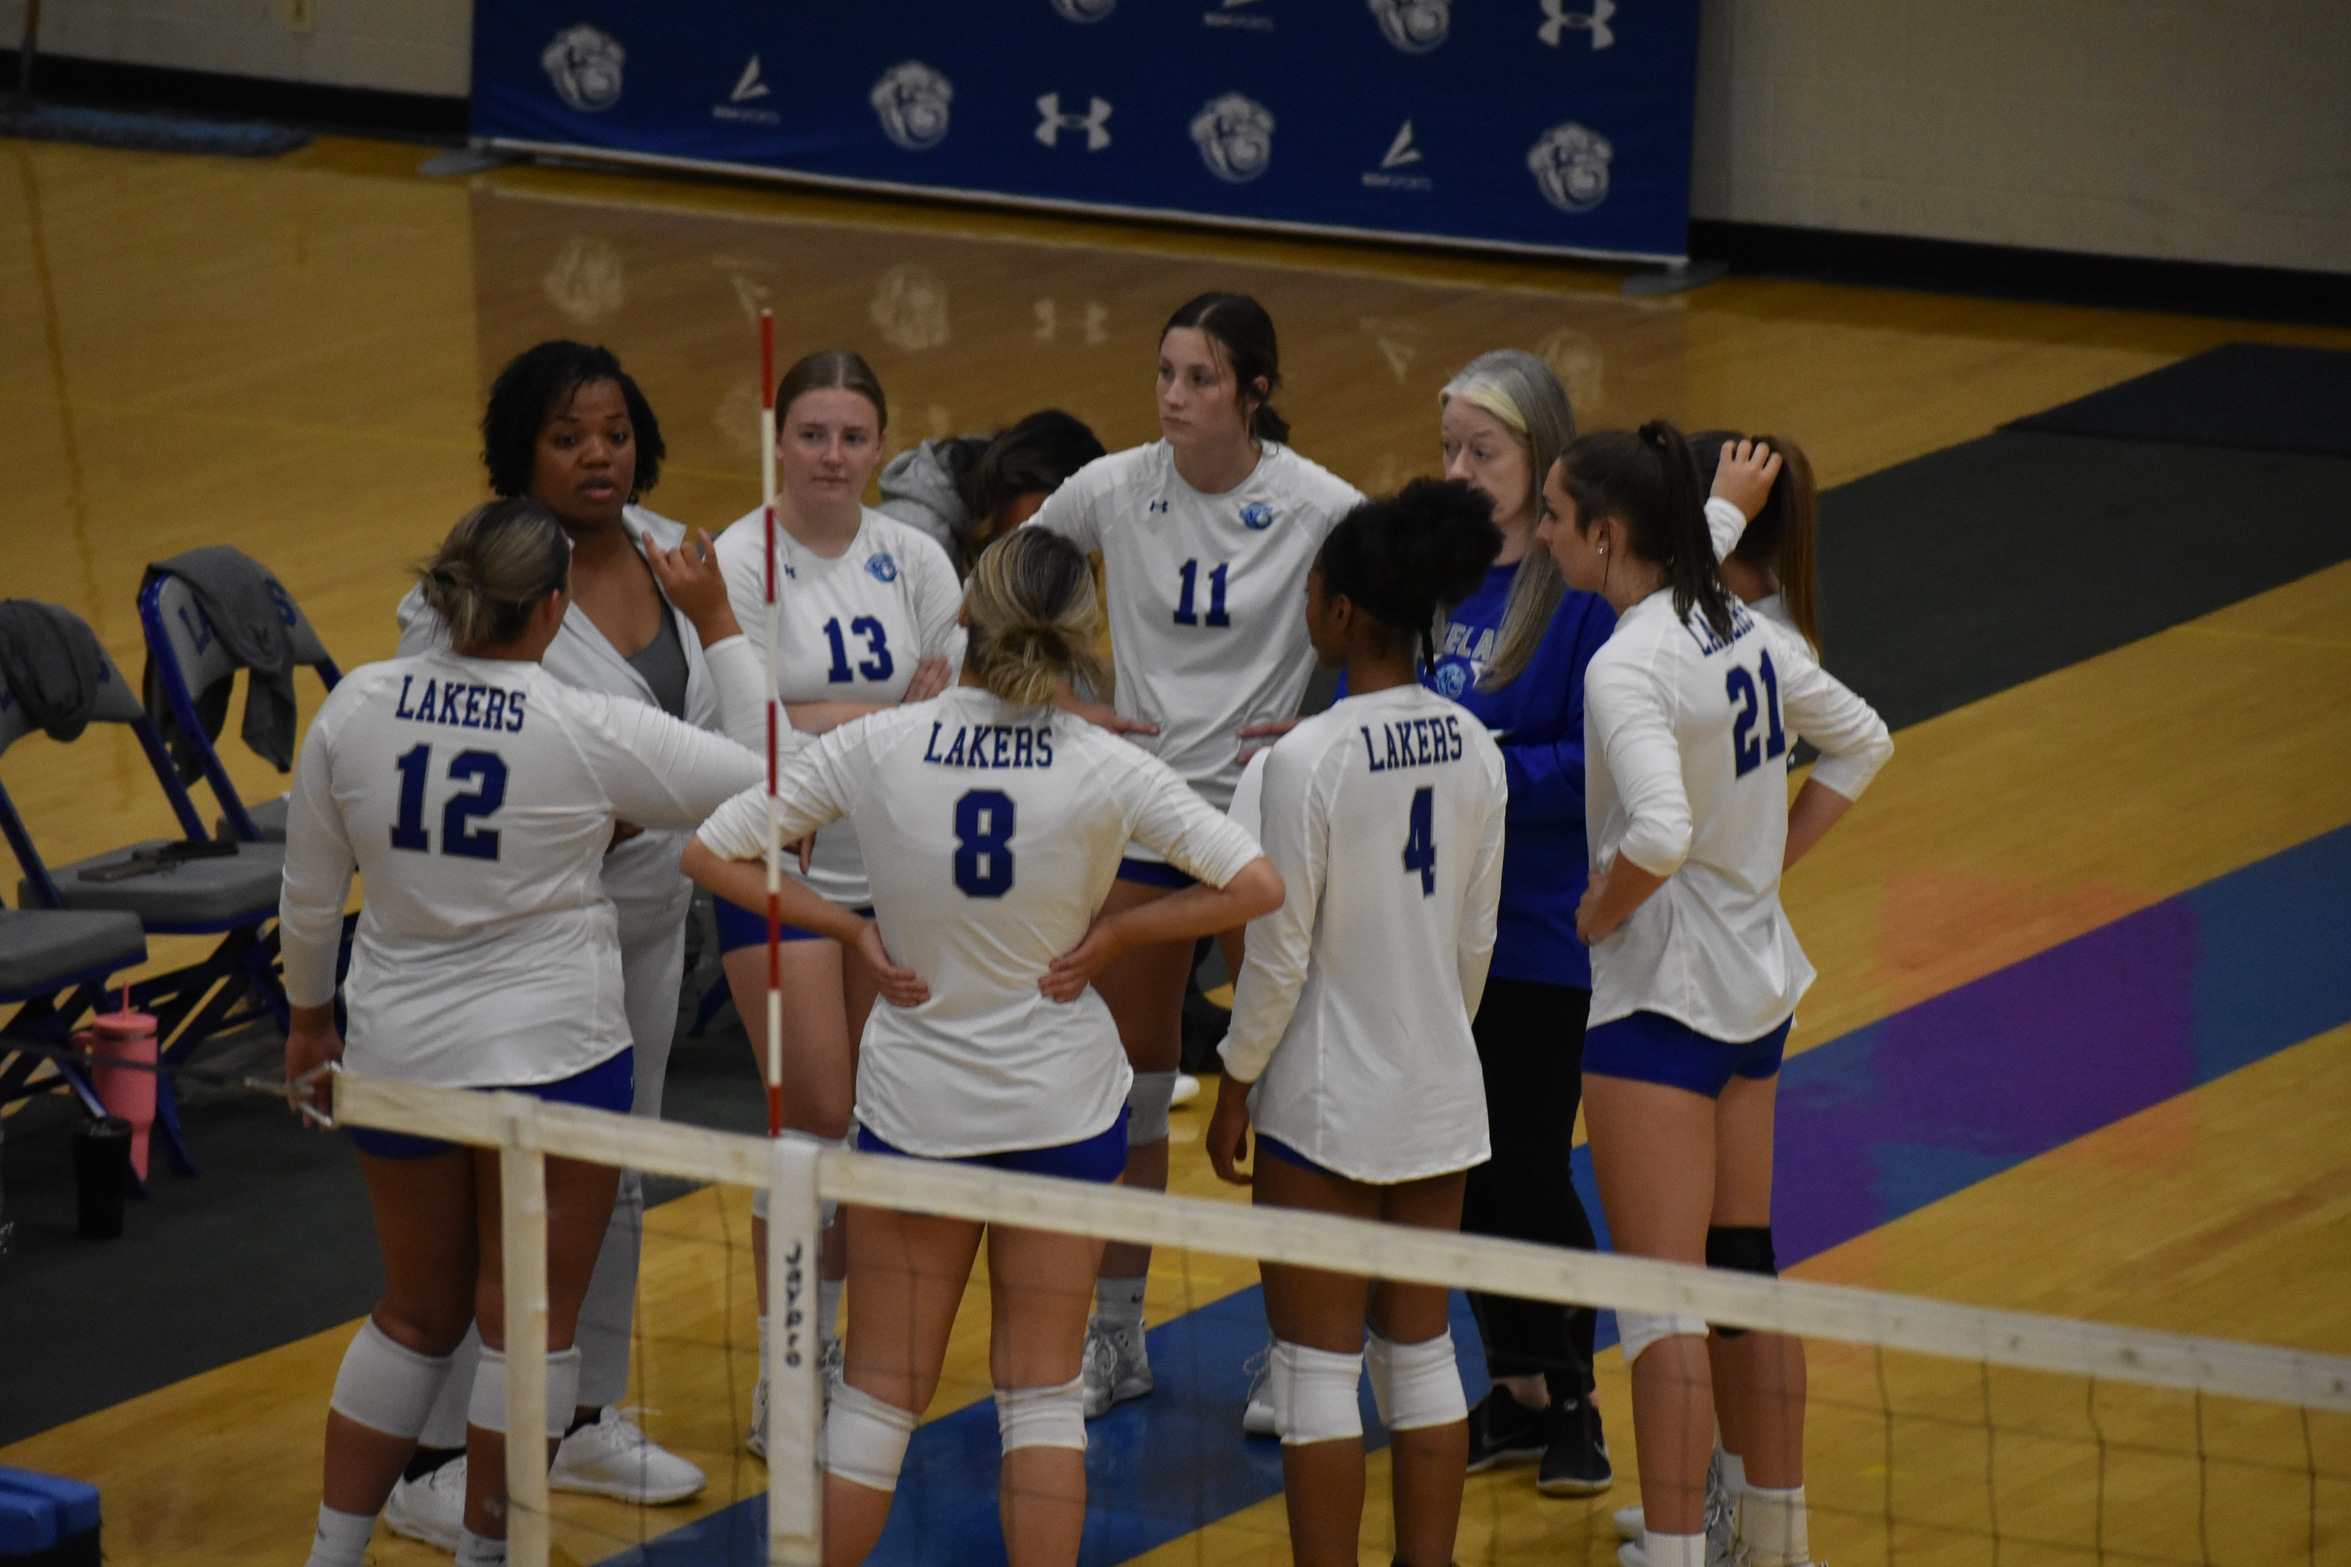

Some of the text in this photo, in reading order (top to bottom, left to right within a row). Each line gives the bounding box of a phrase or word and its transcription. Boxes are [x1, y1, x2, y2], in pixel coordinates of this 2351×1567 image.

[1173, 558, 1231, 627] 11
[824, 615, 894, 683] 13
[395, 674, 527, 733] LAKERS
[1725, 648, 1786, 780] 21
[922, 721, 1054, 770] LAKERS
[1361, 714, 1464, 773] LAKERS
[390, 743, 509, 861] 12
[952, 788, 1017, 899] 8
[1403, 785, 1436, 898] 4
